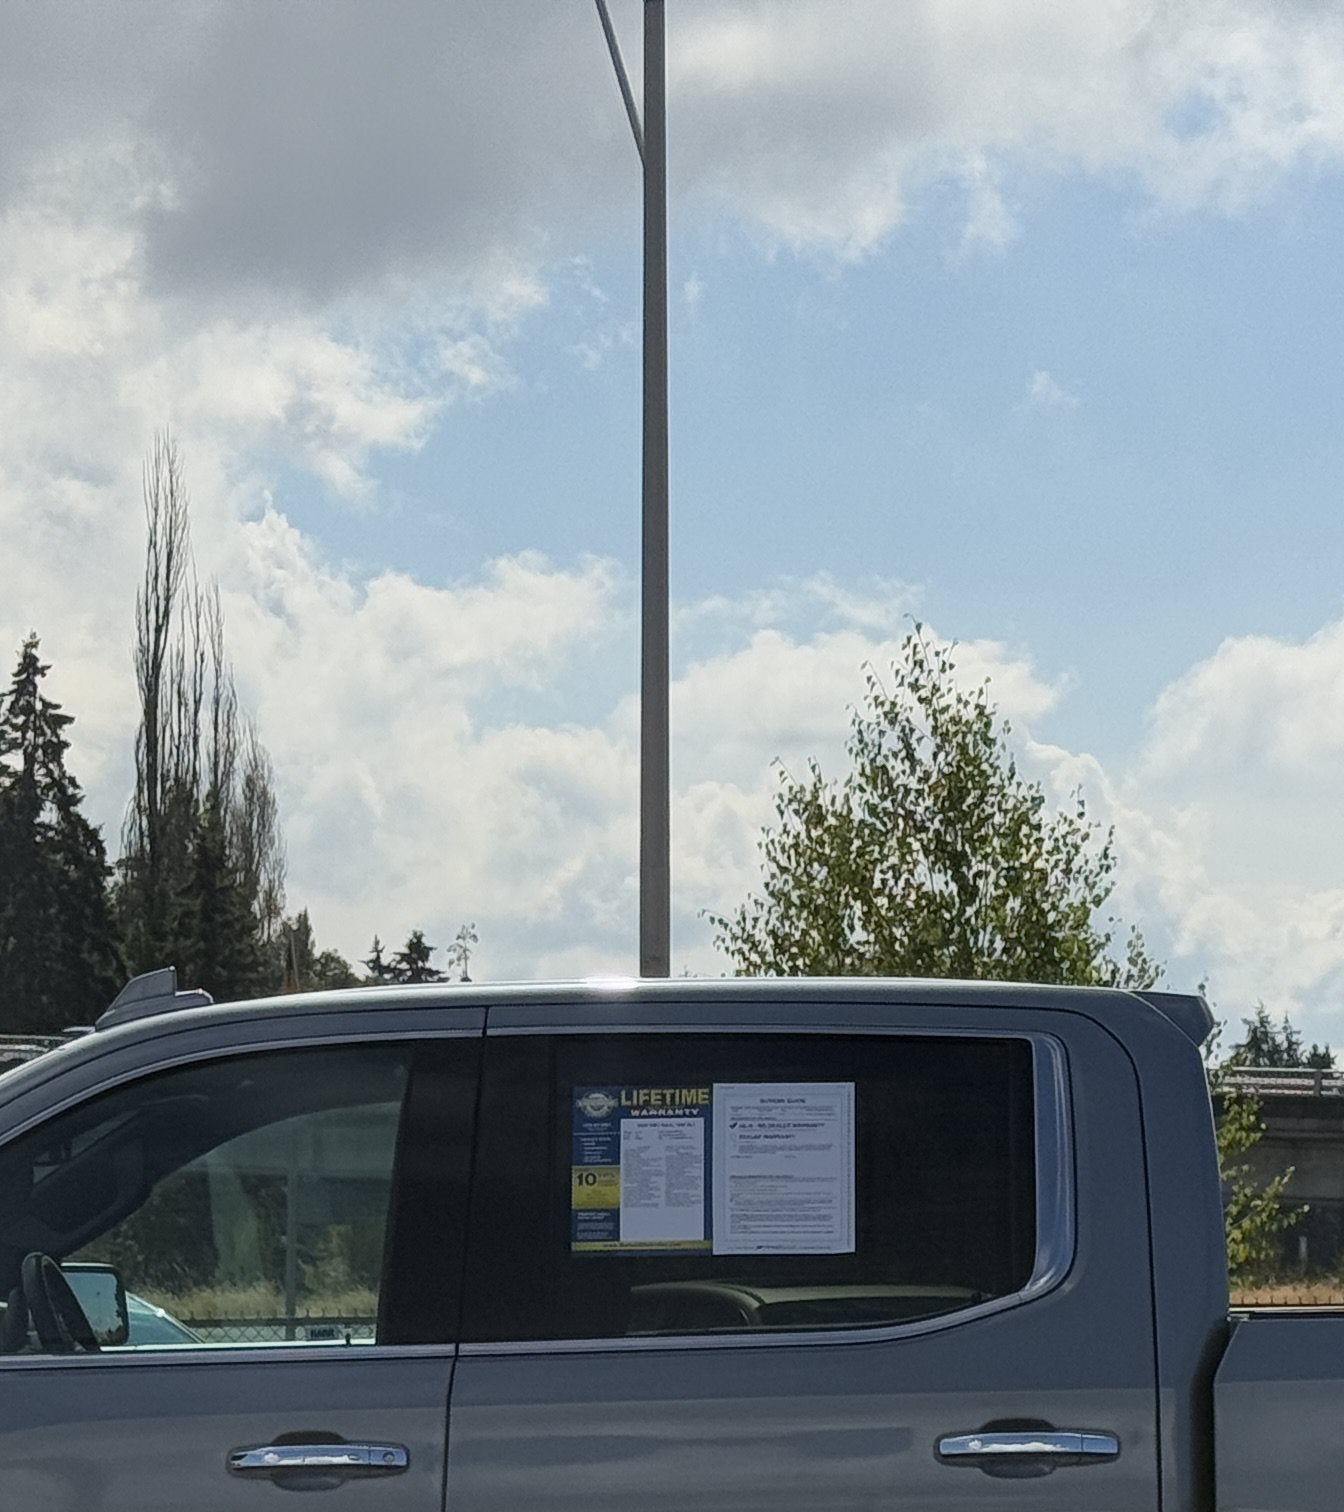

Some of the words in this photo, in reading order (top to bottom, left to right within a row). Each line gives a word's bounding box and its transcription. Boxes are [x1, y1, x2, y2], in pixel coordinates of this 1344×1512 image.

[620, 1088, 709, 1106] LIFETIME
[631, 1108, 699, 1116] WARRANTY
[577, 1172, 597, 1186] 10
